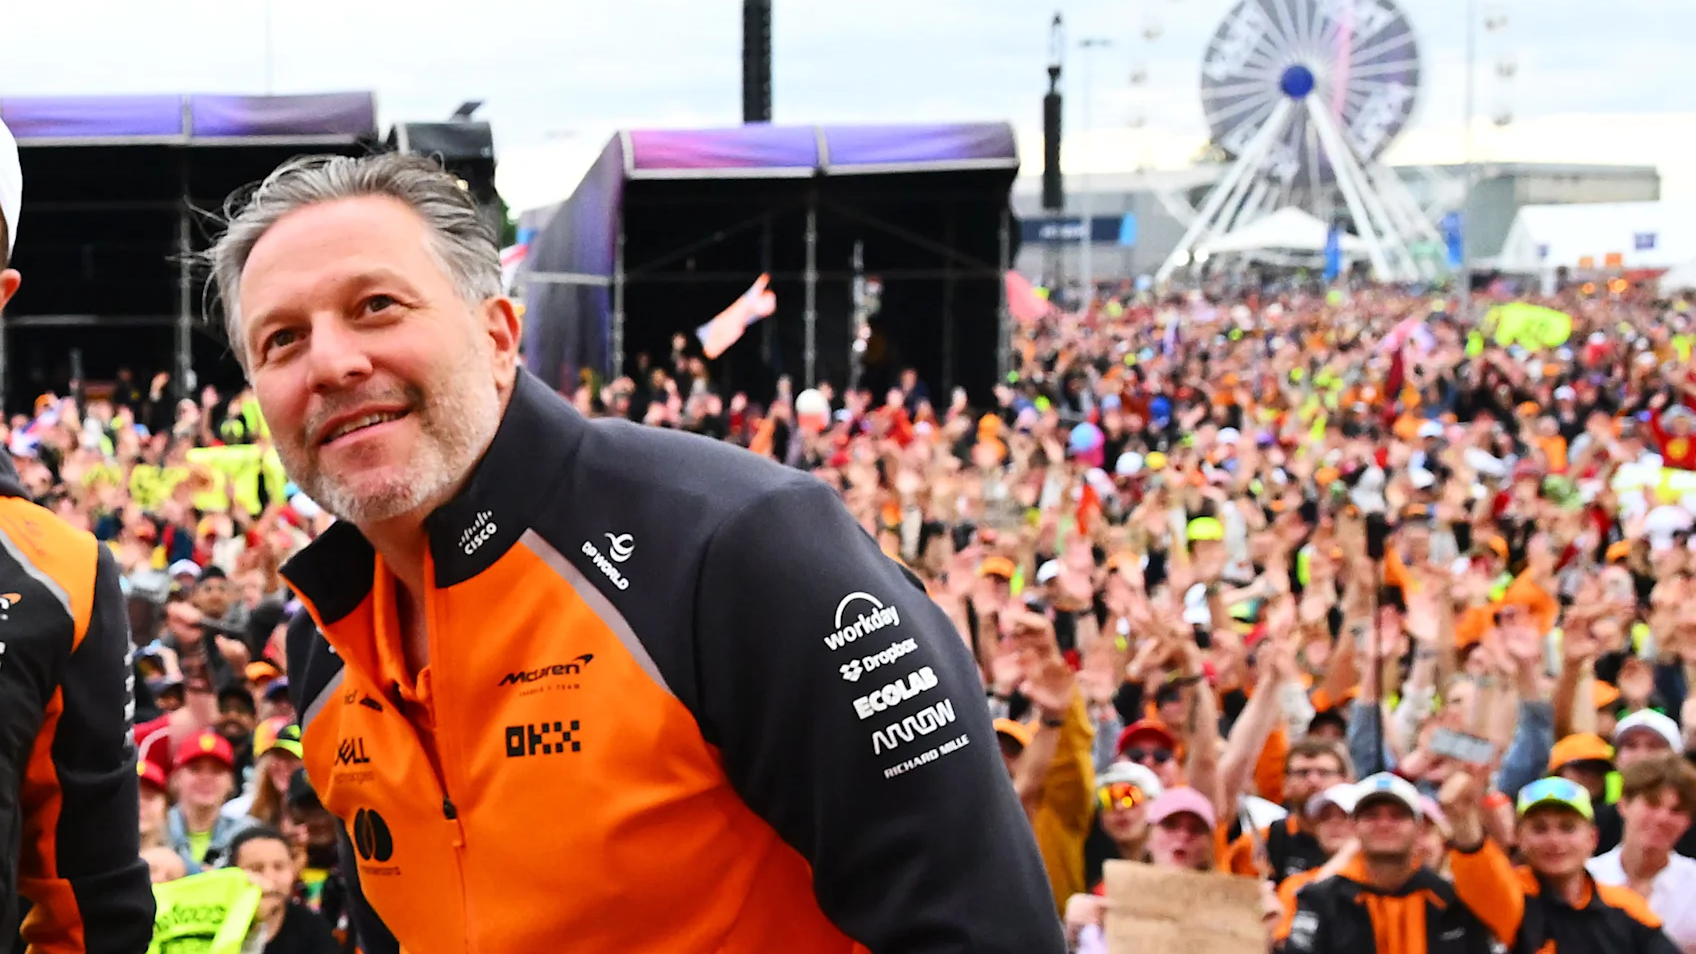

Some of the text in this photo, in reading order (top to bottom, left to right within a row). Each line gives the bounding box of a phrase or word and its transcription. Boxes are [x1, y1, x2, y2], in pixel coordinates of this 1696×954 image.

[592, 551, 630, 591] WORLD
[823, 605, 901, 651] workday
[862, 638, 919, 673] Dropbox
[853, 666, 939, 720] ECOLAB
[505, 720, 581, 758] OKX
[884, 733, 971, 780] RICHARD MILLE
